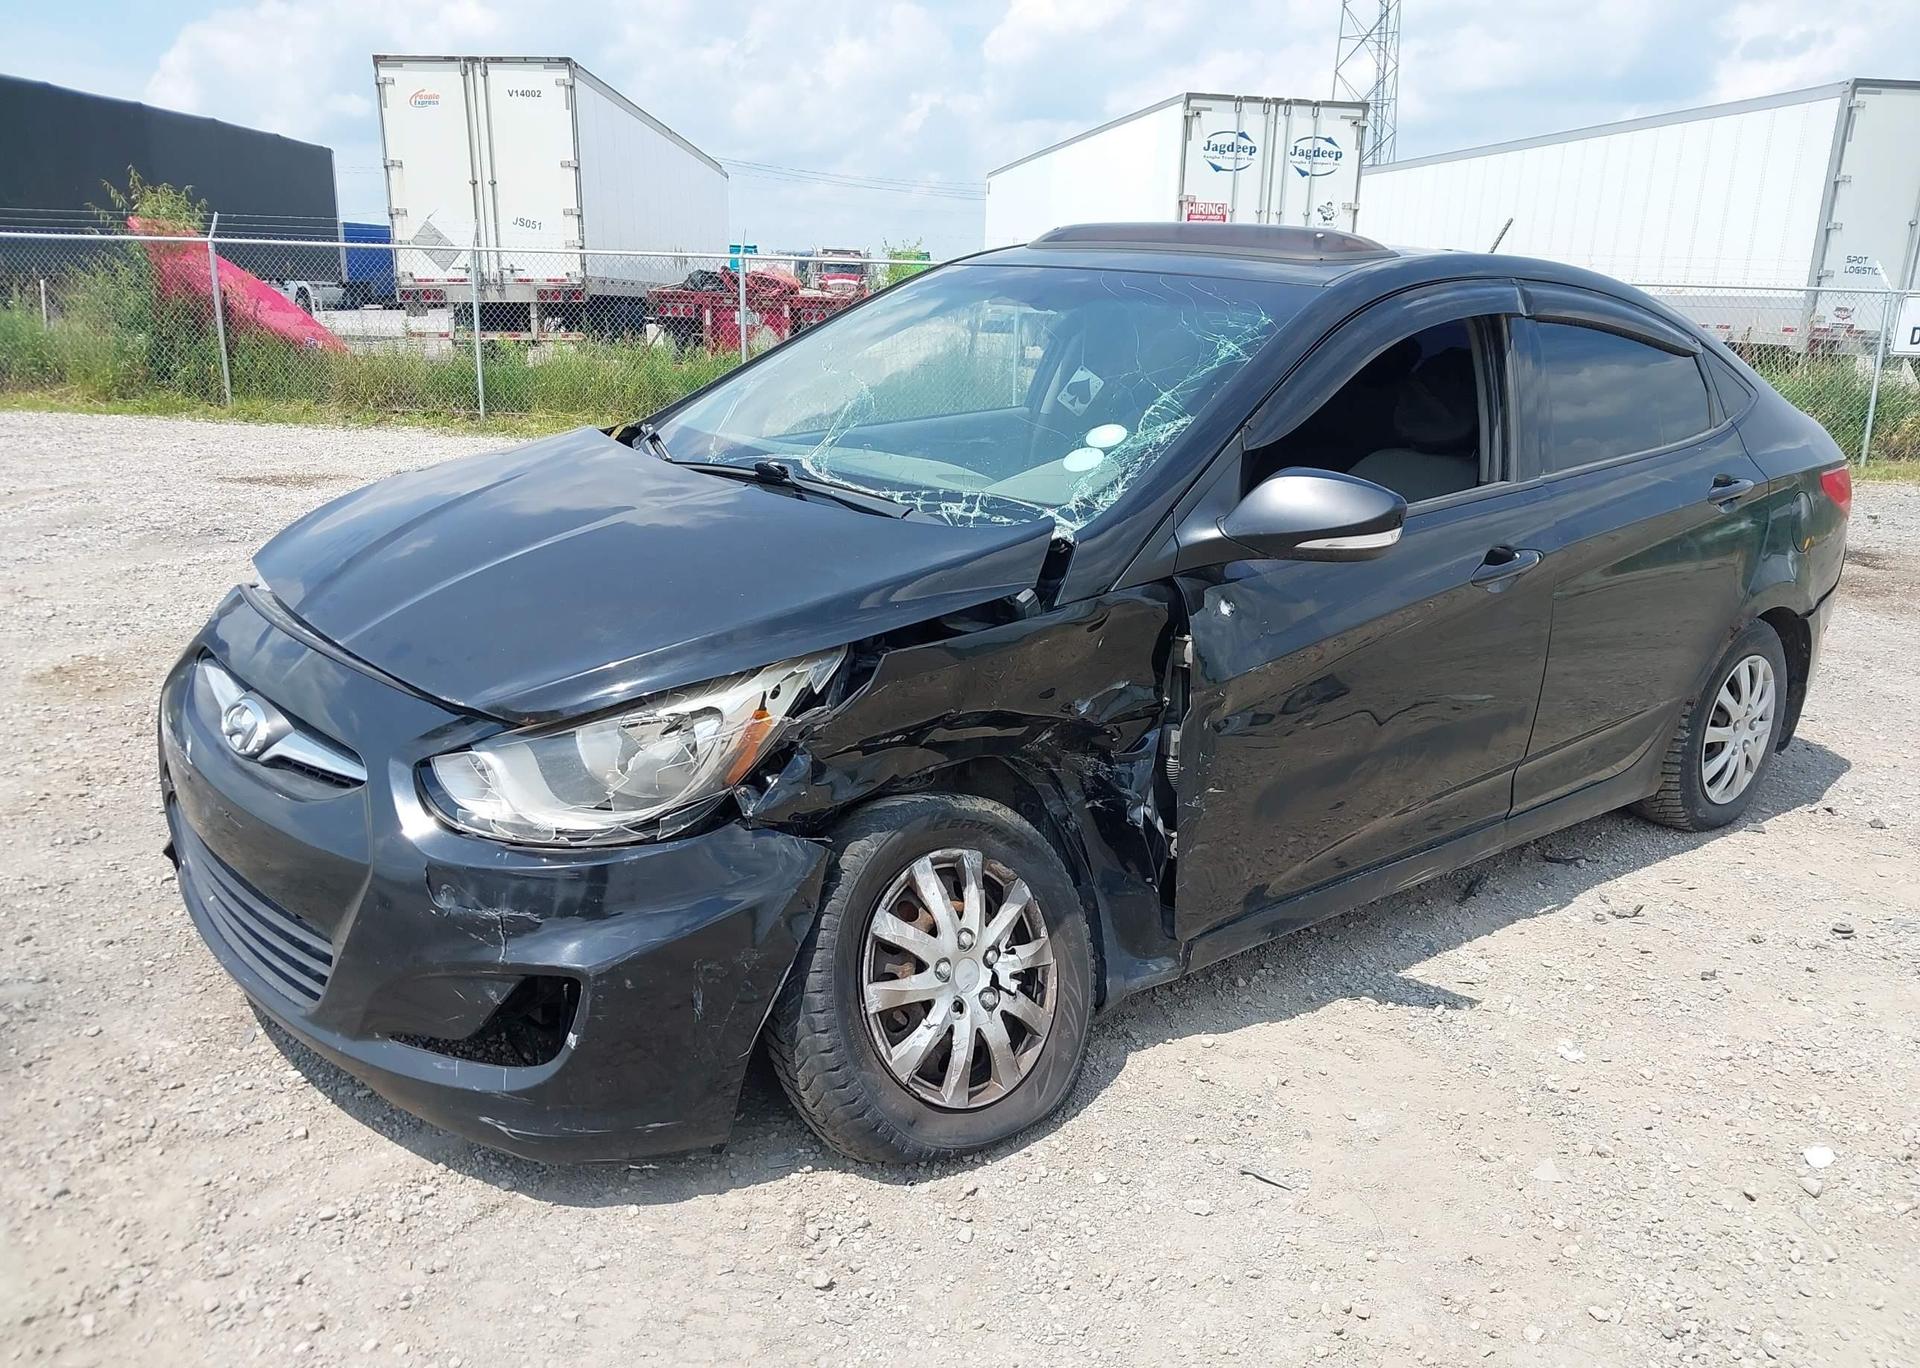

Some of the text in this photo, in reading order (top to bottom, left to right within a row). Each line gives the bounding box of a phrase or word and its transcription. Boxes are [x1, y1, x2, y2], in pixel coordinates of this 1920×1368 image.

[507, 88, 542, 98] V14002
[1203, 139, 1257, 156] Jagdeep
[1289, 145, 1343, 161] Jagdeep
[512, 216, 542, 231] JS051
[1846, 255, 1869, 265] SPOT
